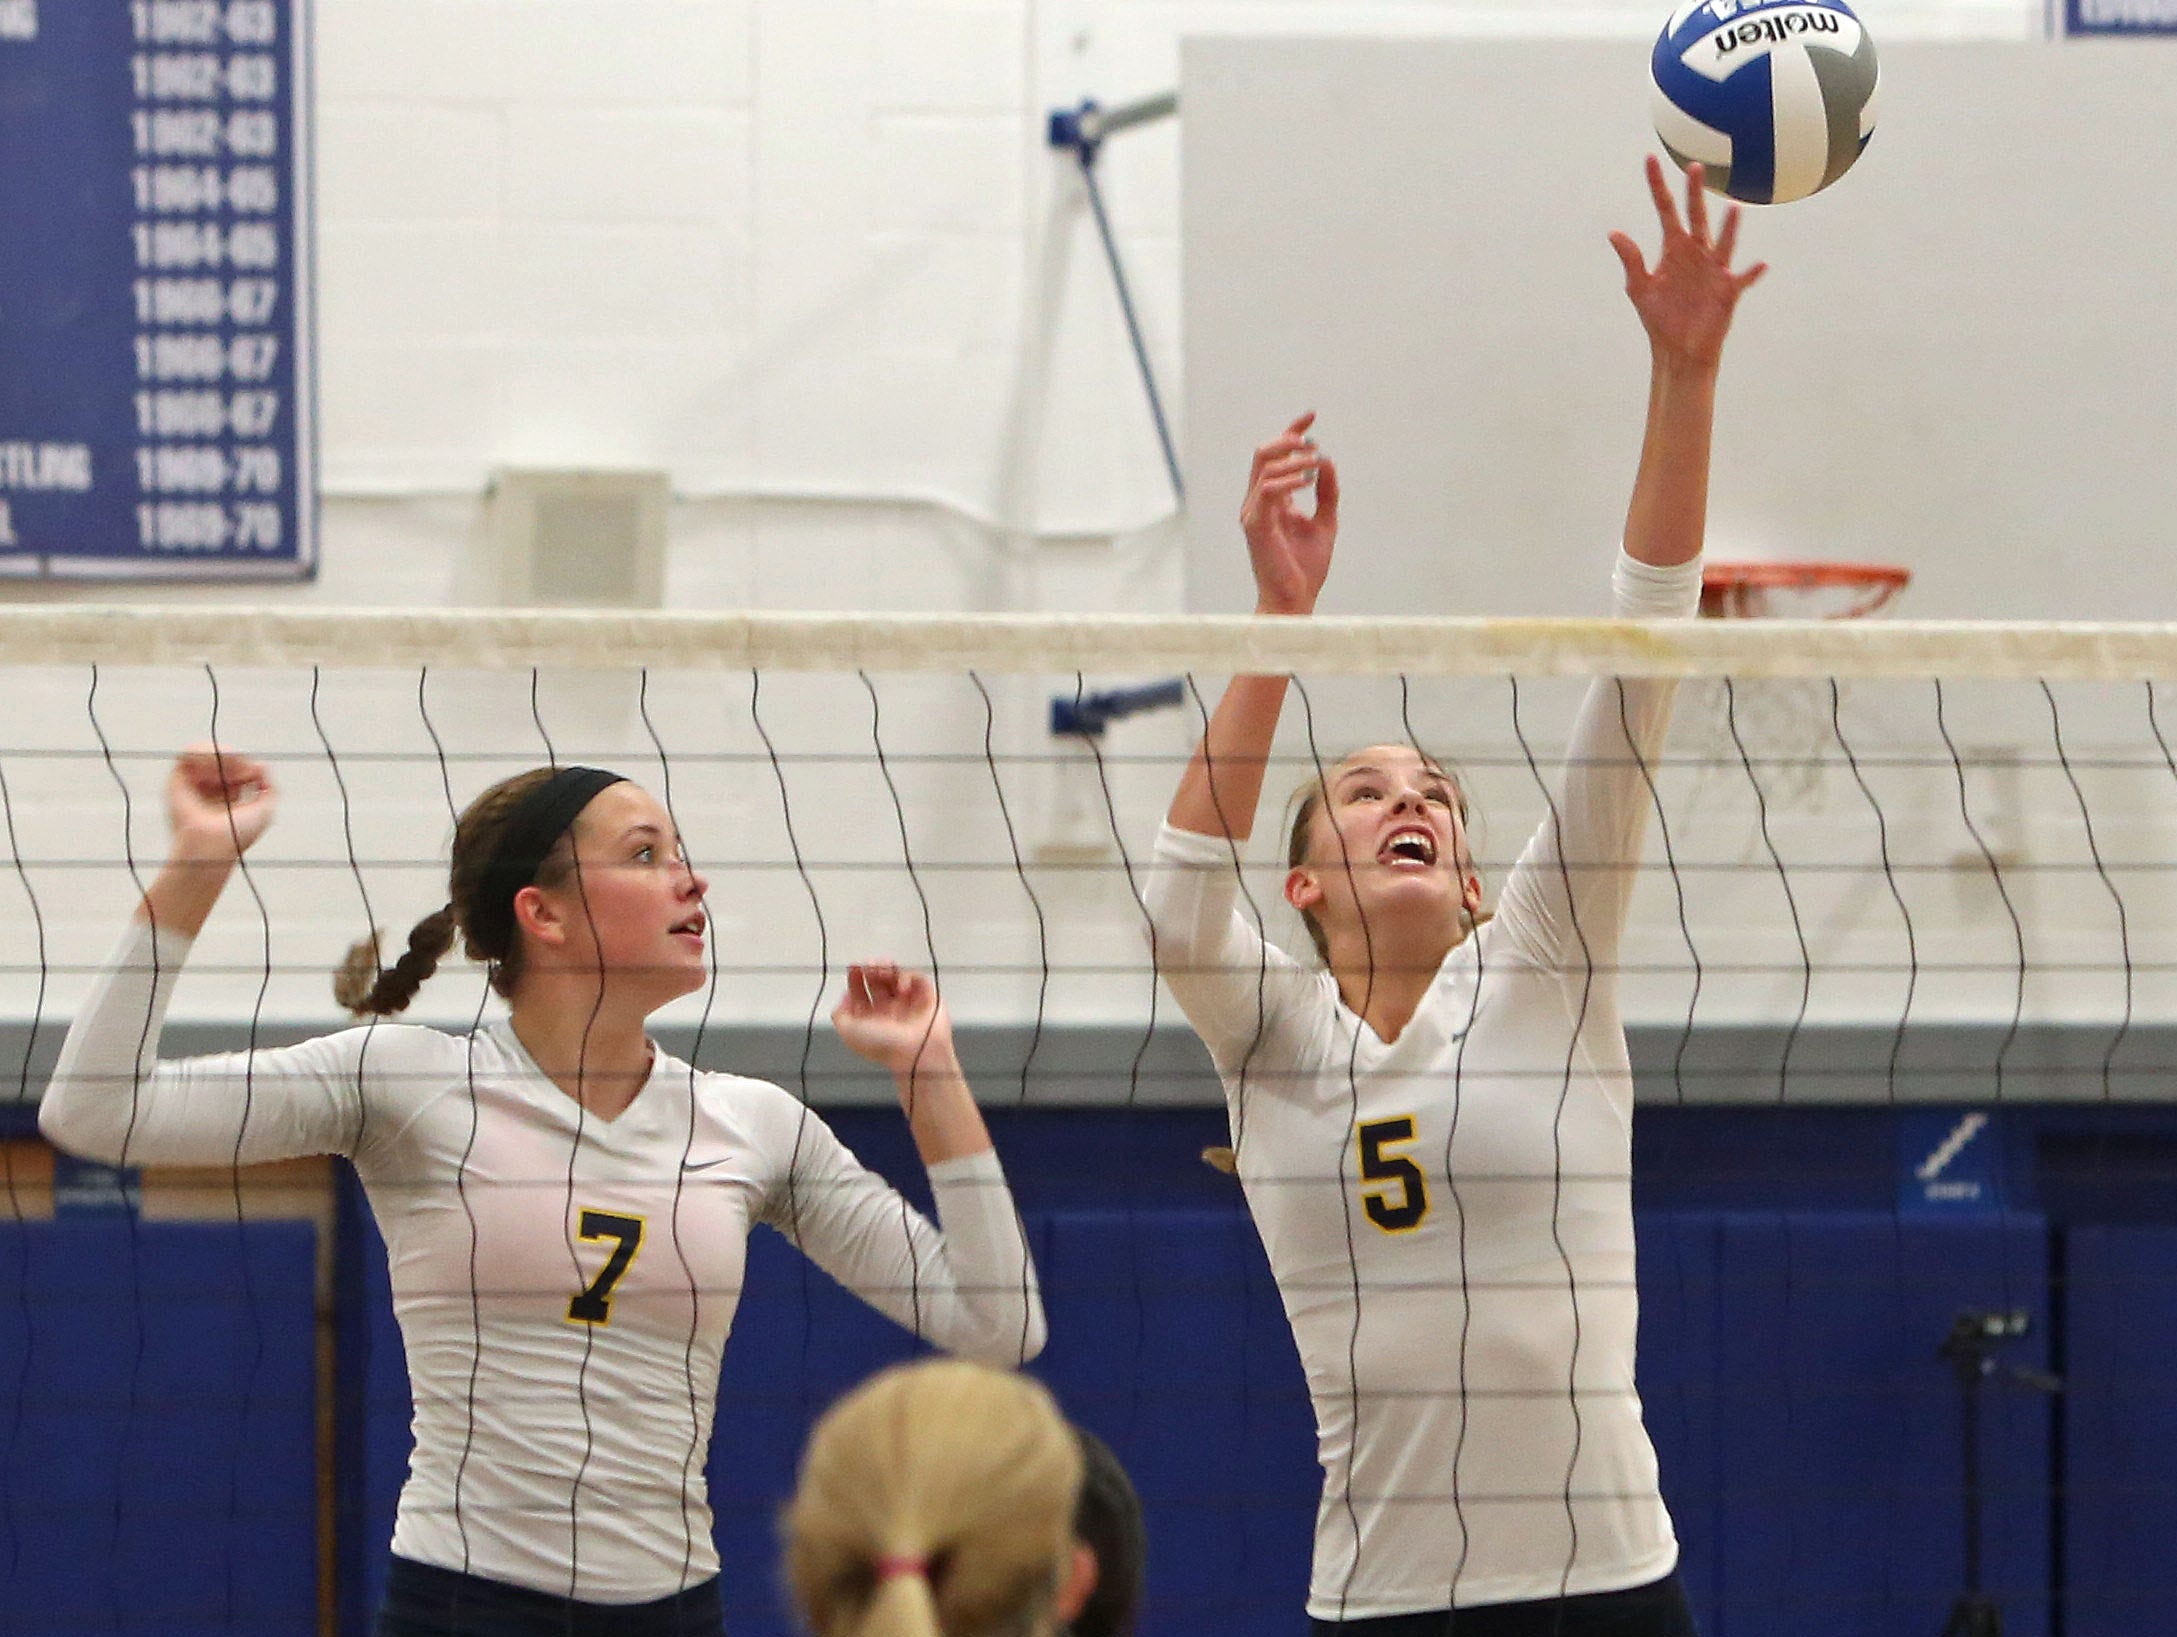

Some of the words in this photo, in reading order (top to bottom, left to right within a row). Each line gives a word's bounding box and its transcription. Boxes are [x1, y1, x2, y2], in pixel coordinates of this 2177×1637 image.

[1714, 12, 1839, 52] molten
[1356, 1113, 1432, 1236] 5
[565, 1207, 647, 1326] 7
